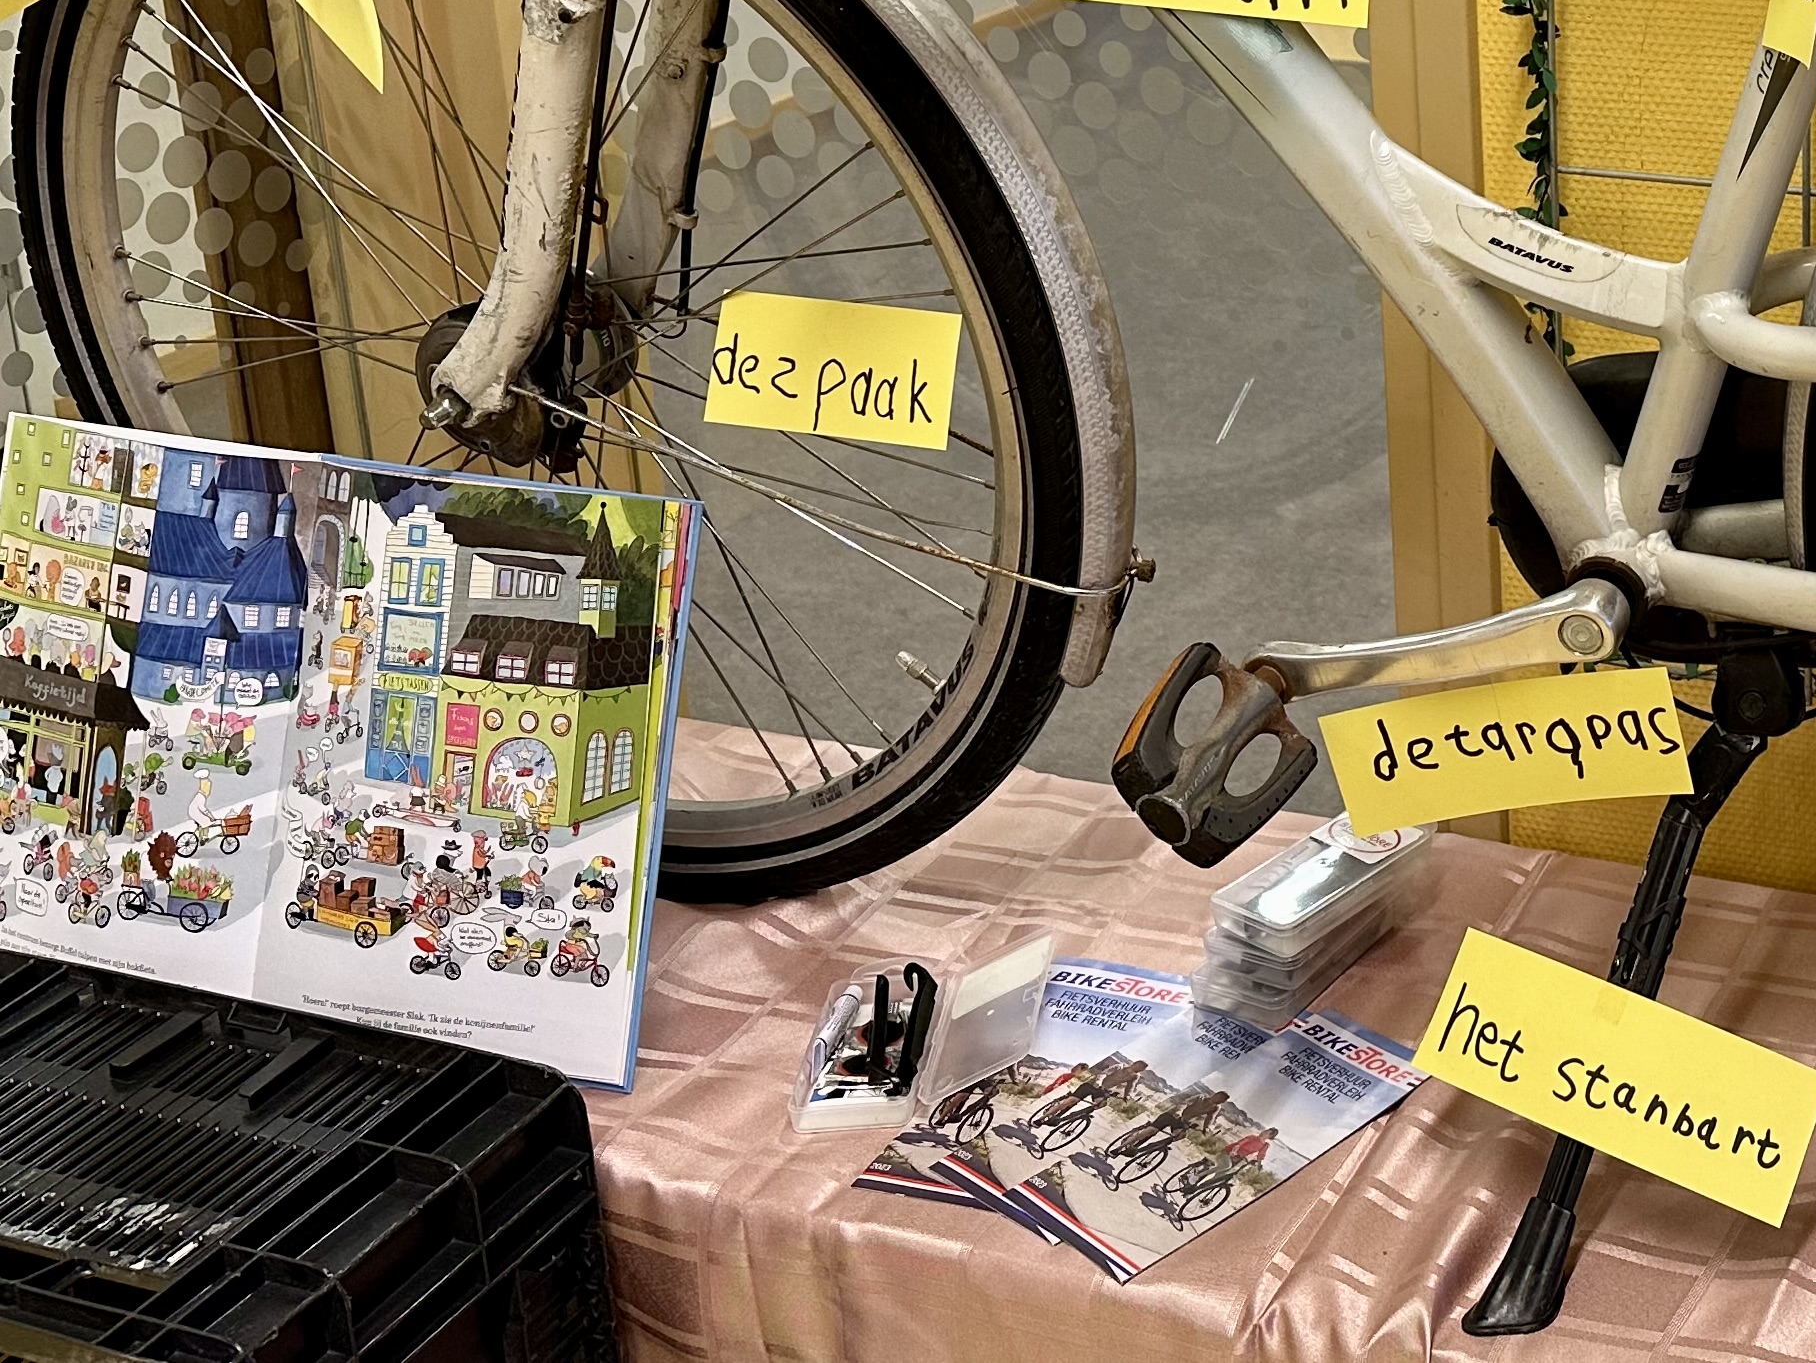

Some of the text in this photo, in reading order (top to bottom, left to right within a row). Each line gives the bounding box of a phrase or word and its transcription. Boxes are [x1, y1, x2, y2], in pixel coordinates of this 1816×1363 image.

[1488, 237, 1574, 273] BATAVUS
[1050, 971, 1189, 1004] BIKESTORE
[1059, 990, 1152, 1014] FIETSVERHUUR
[1045, 998, 1153, 1025] FAHRRADVERLEIH
[1051, 1009, 1128, 1032] BIKE RENTAL
[1194, 1033, 1221, 1051] BIKE
[1437, 982, 1525, 1083] het
[1297, 1047, 1372, 1091] FIETSVERHUUR
[1302, 1024, 1413, 1083] BIKESTORE
[1278, 1065, 1342, 1105] BIKE RENTAL
[1280, 1051, 1367, 1102] FAHRRADVERLEIH
